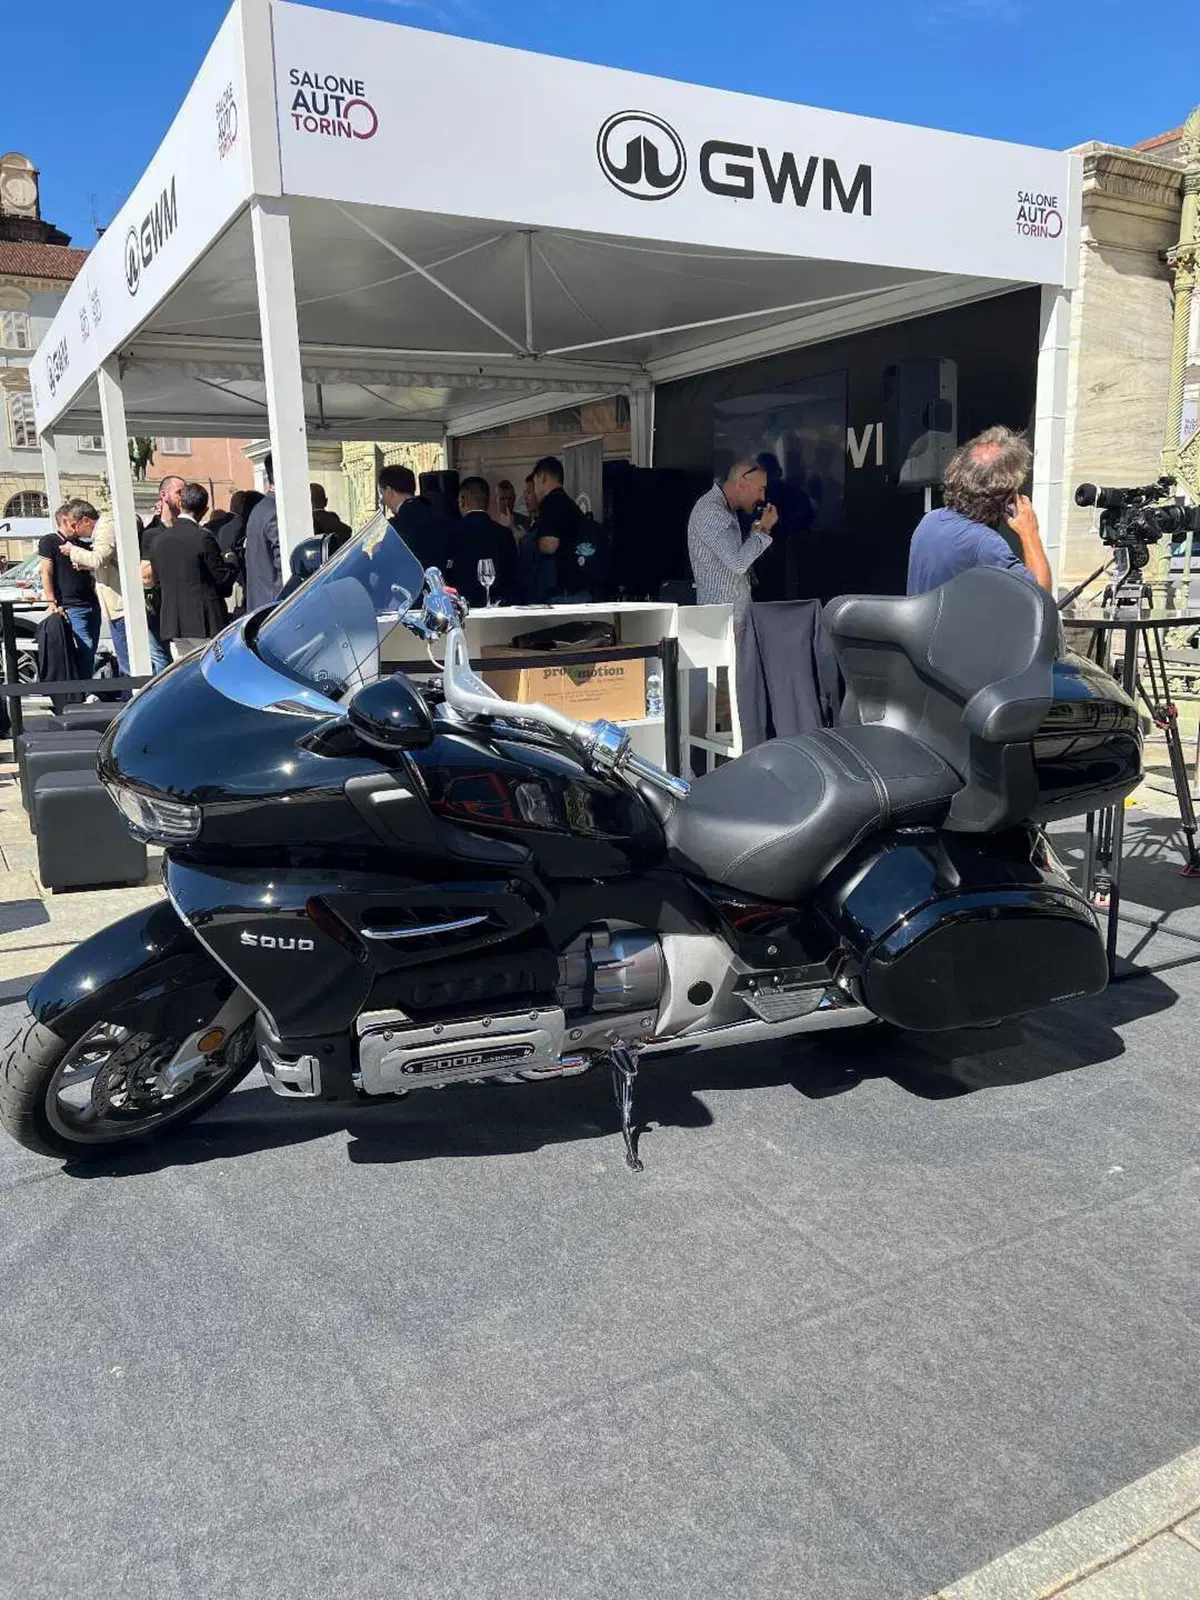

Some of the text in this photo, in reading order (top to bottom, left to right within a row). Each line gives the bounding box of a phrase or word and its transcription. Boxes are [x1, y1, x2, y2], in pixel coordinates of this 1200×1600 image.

[289, 68, 366, 97] SALONE
[291, 89, 378, 128] AUTO
[290, 107, 379, 140] TORINO
[700, 139, 872, 217] GWM
[1017, 190, 1058, 209] SALONE
[140, 174, 178, 269] GWM
[1016, 205, 1063, 231] AUTO
[1016, 217, 1063, 239] TORINO
[240, 930, 315, 951] SOUO
[421, 1054, 483, 1073] 2000
